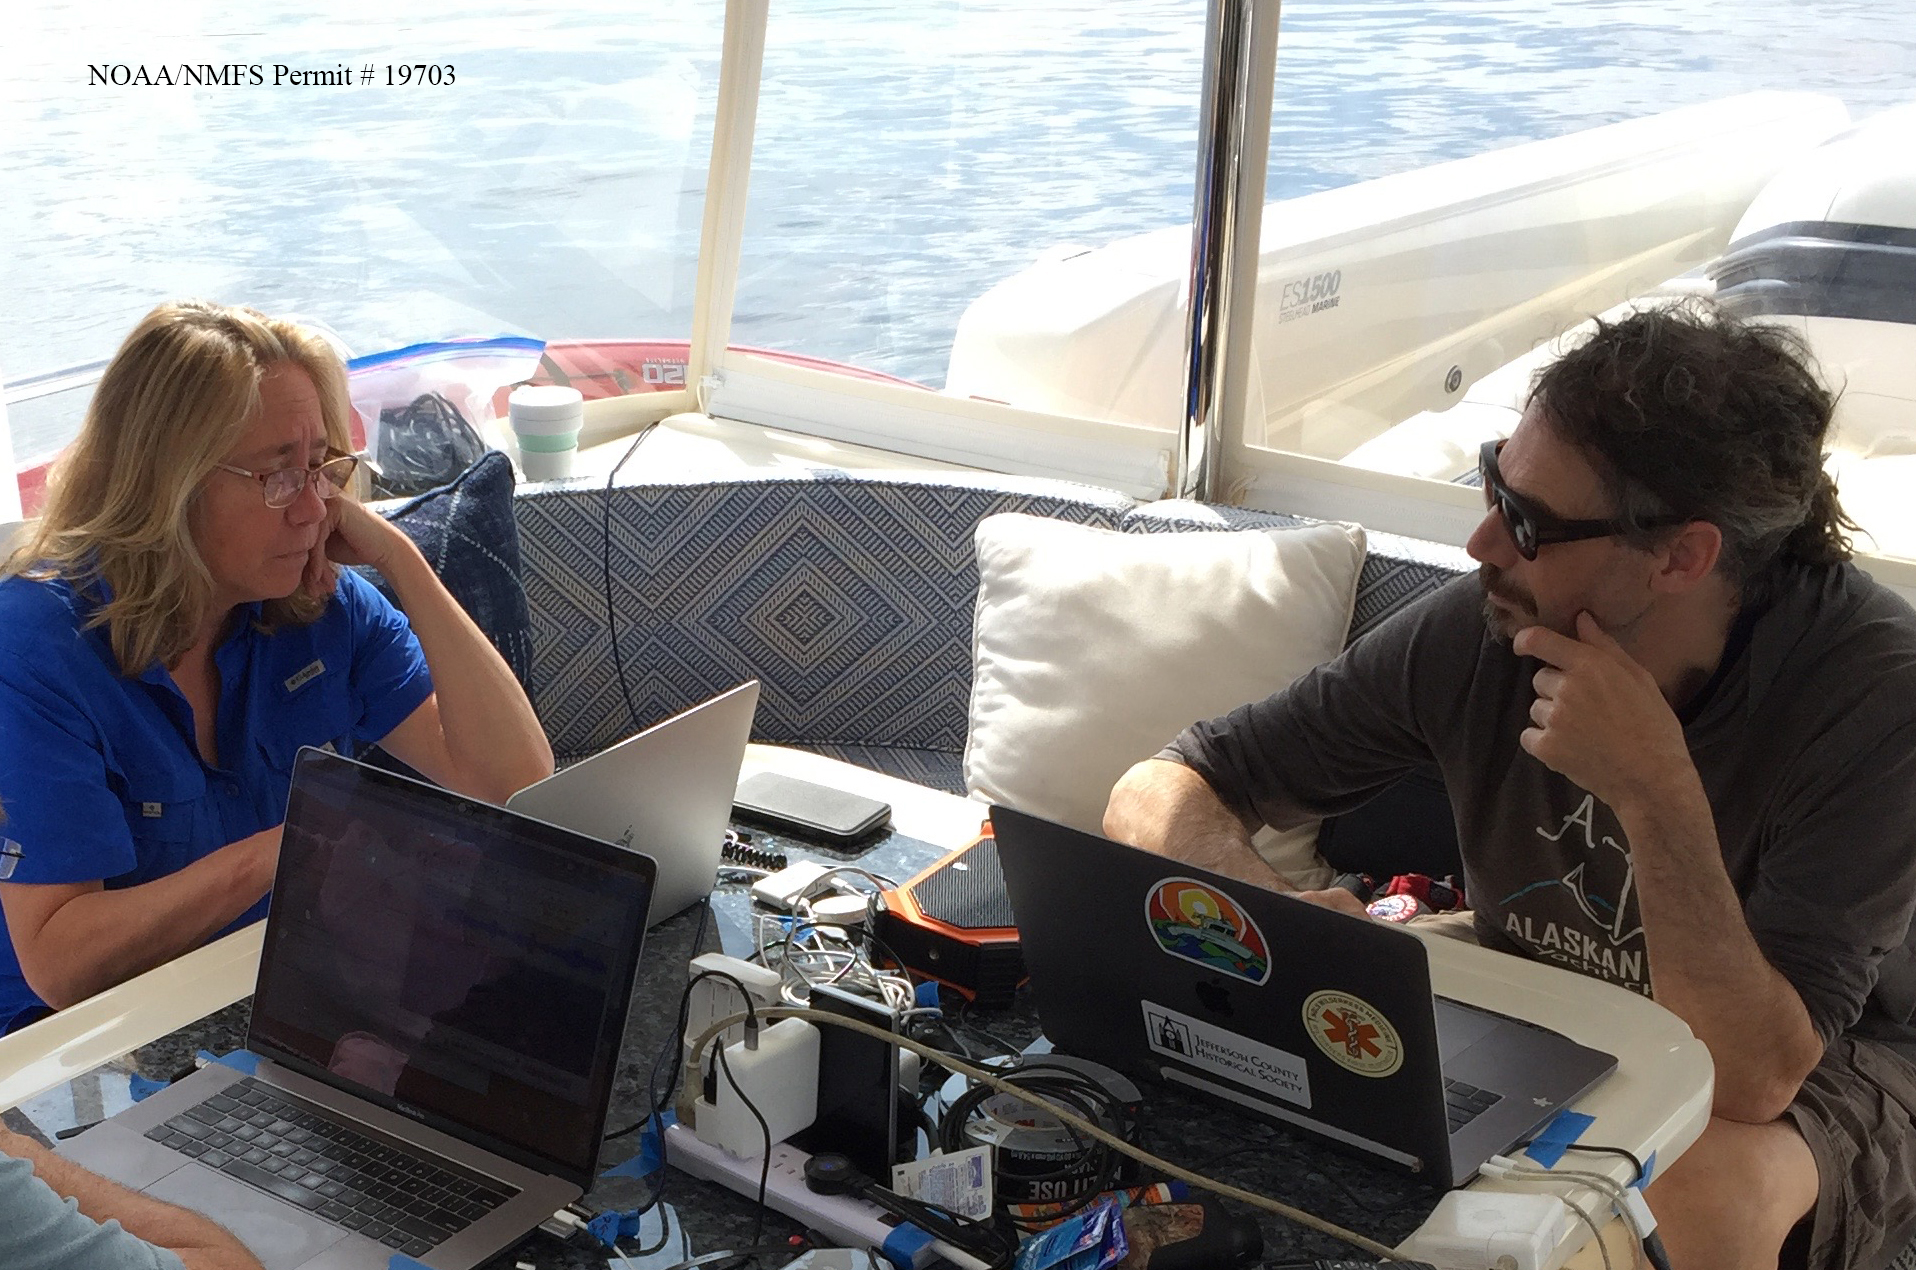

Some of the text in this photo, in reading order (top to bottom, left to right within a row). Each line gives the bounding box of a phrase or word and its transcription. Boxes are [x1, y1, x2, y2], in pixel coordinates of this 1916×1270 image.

[1280, 270, 1341, 311] ES1500
[1312, 296, 1340, 314] MARINE
[1506, 912, 1641, 981] ALASKAN
[1028, 1180, 1067, 1200] USE
